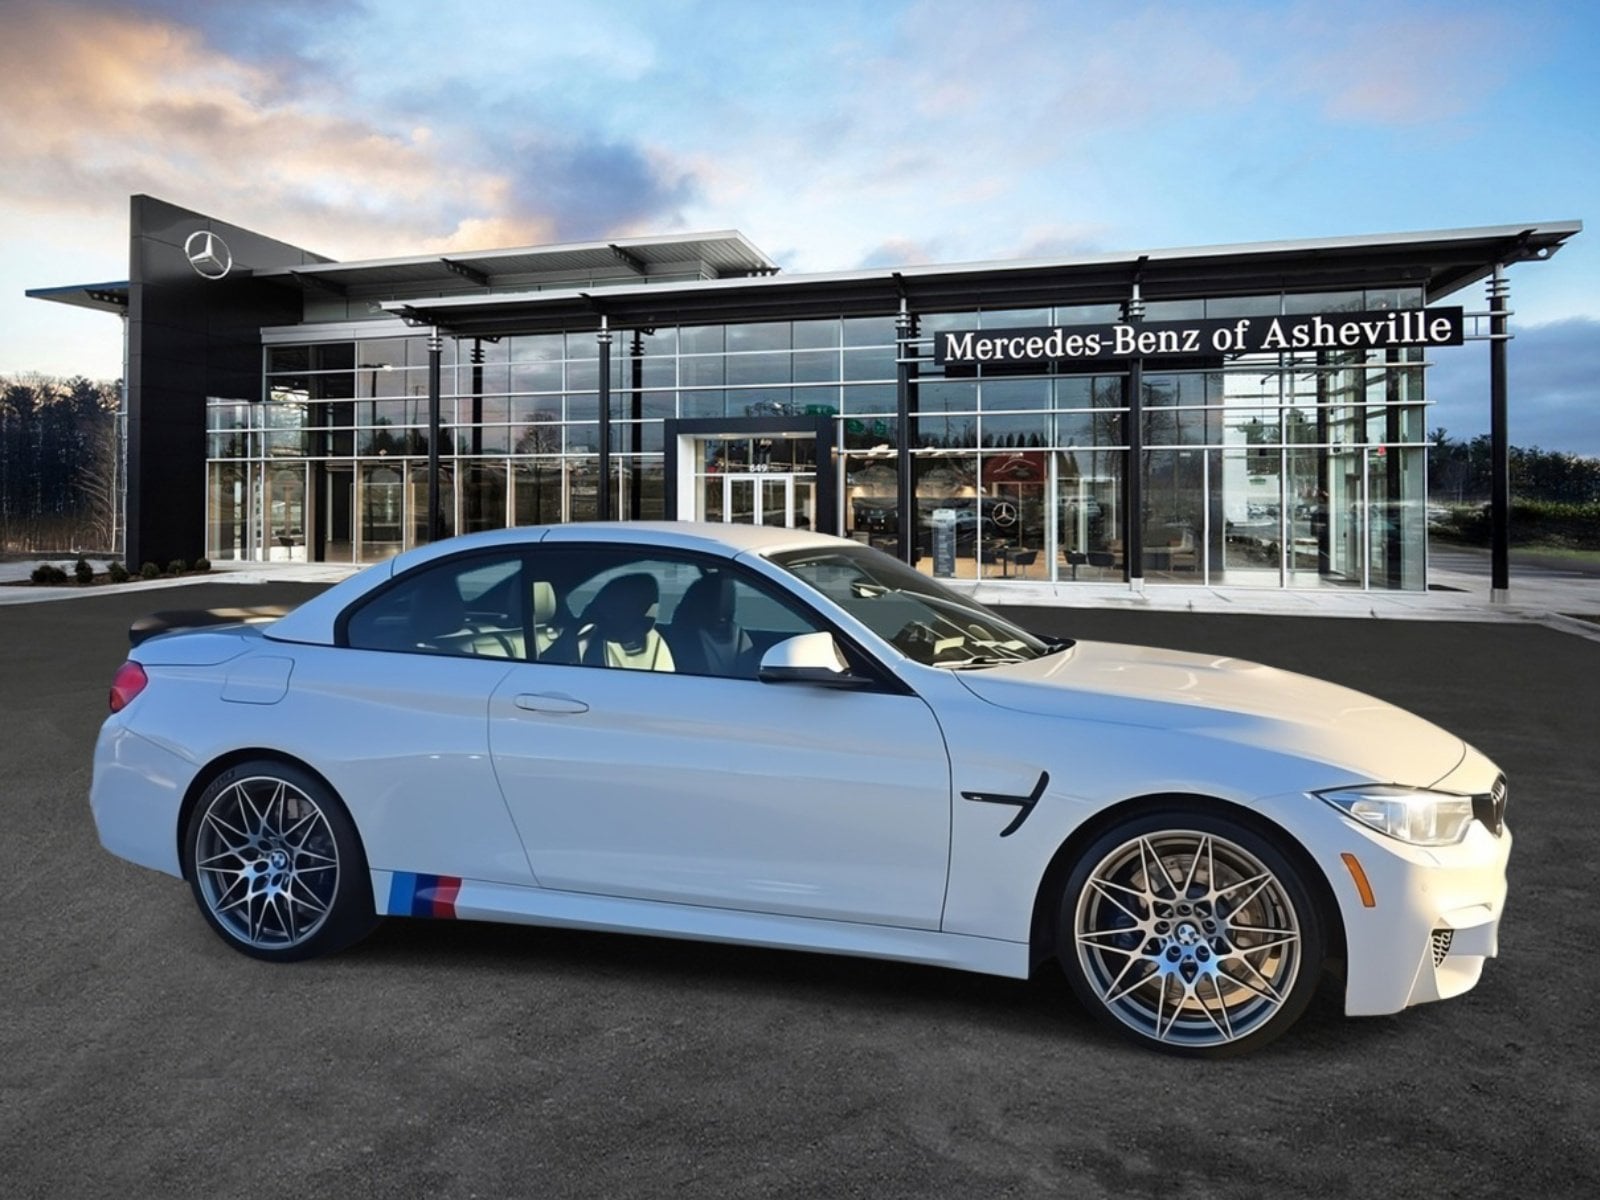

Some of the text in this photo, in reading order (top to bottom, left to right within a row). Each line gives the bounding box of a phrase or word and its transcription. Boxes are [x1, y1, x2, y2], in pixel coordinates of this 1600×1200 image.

[944, 311, 1452, 361] Mercedes-Benz of Asheville
